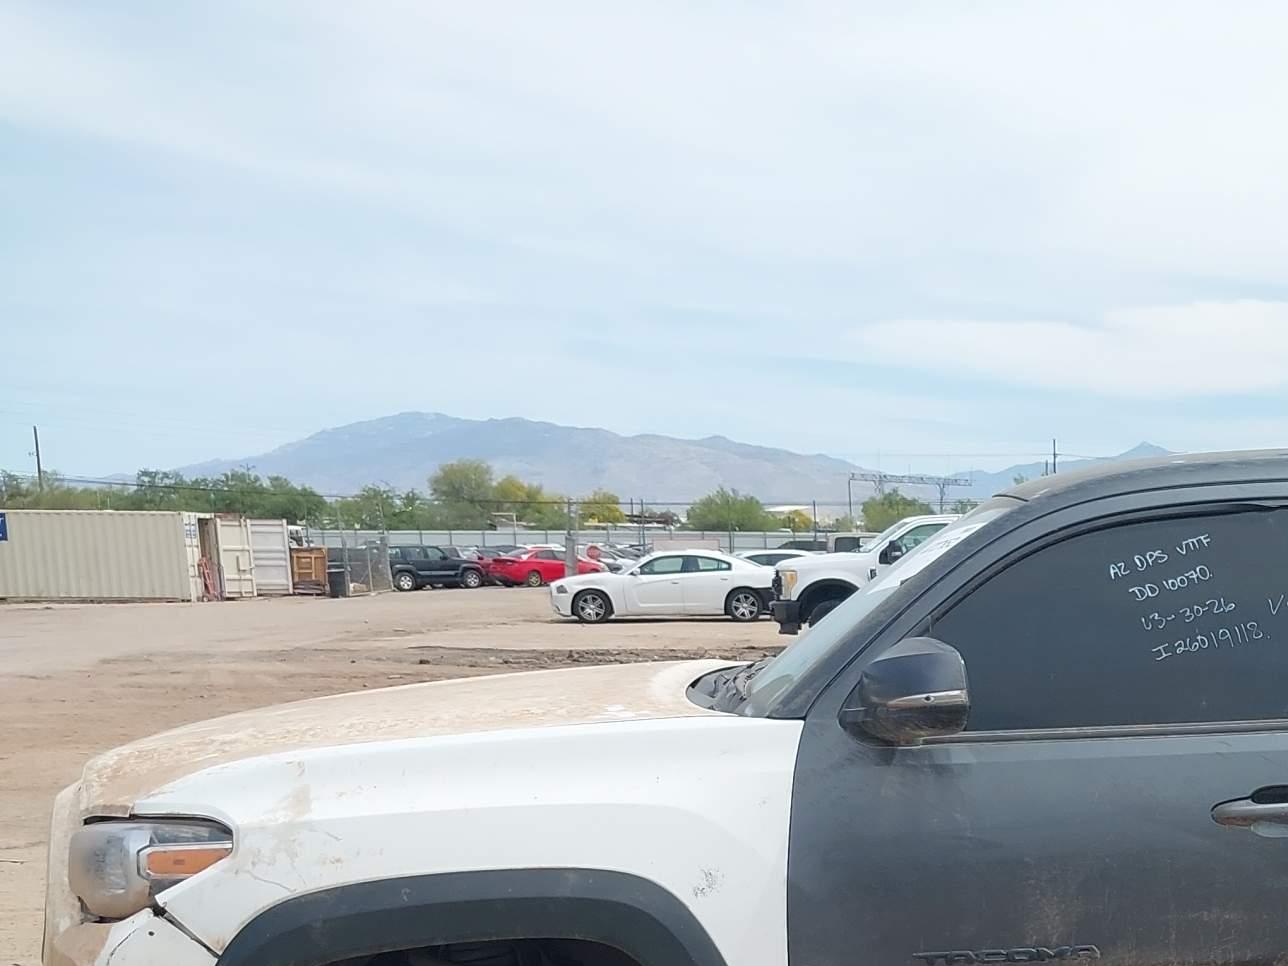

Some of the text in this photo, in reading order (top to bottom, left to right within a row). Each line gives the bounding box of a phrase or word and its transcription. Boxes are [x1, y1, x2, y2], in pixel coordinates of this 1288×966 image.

[1109, 562, 1131, 580] AZ
[1133, 549, 1169, 572] DPS
[1128, 582, 1160, 602] DD
